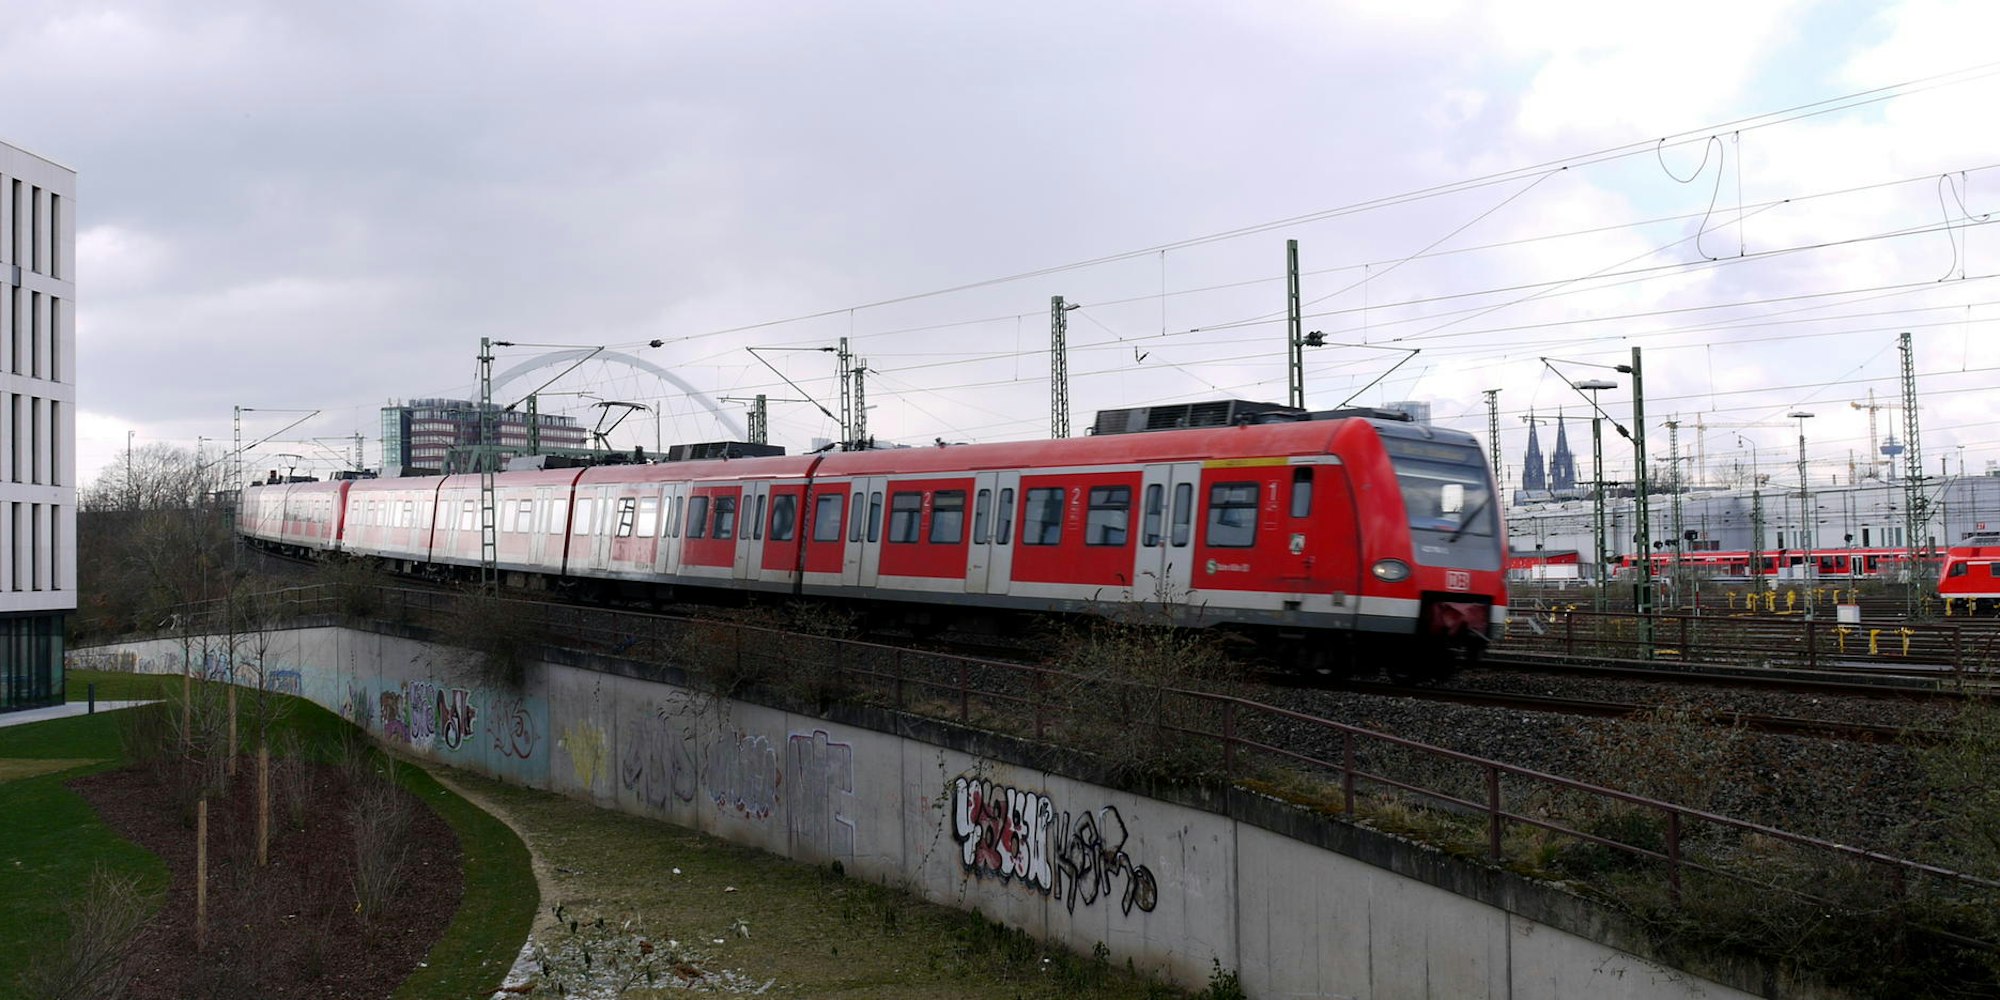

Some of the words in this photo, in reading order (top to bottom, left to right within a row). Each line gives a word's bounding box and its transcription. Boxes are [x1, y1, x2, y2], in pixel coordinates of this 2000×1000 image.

[923, 491, 931, 506] 2
[1071, 487, 1081, 505] 2
[1268, 482, 1277, 501] 1
[1206, 559, 1217, 575] S
[1447, 572, 1470, 590] DB
